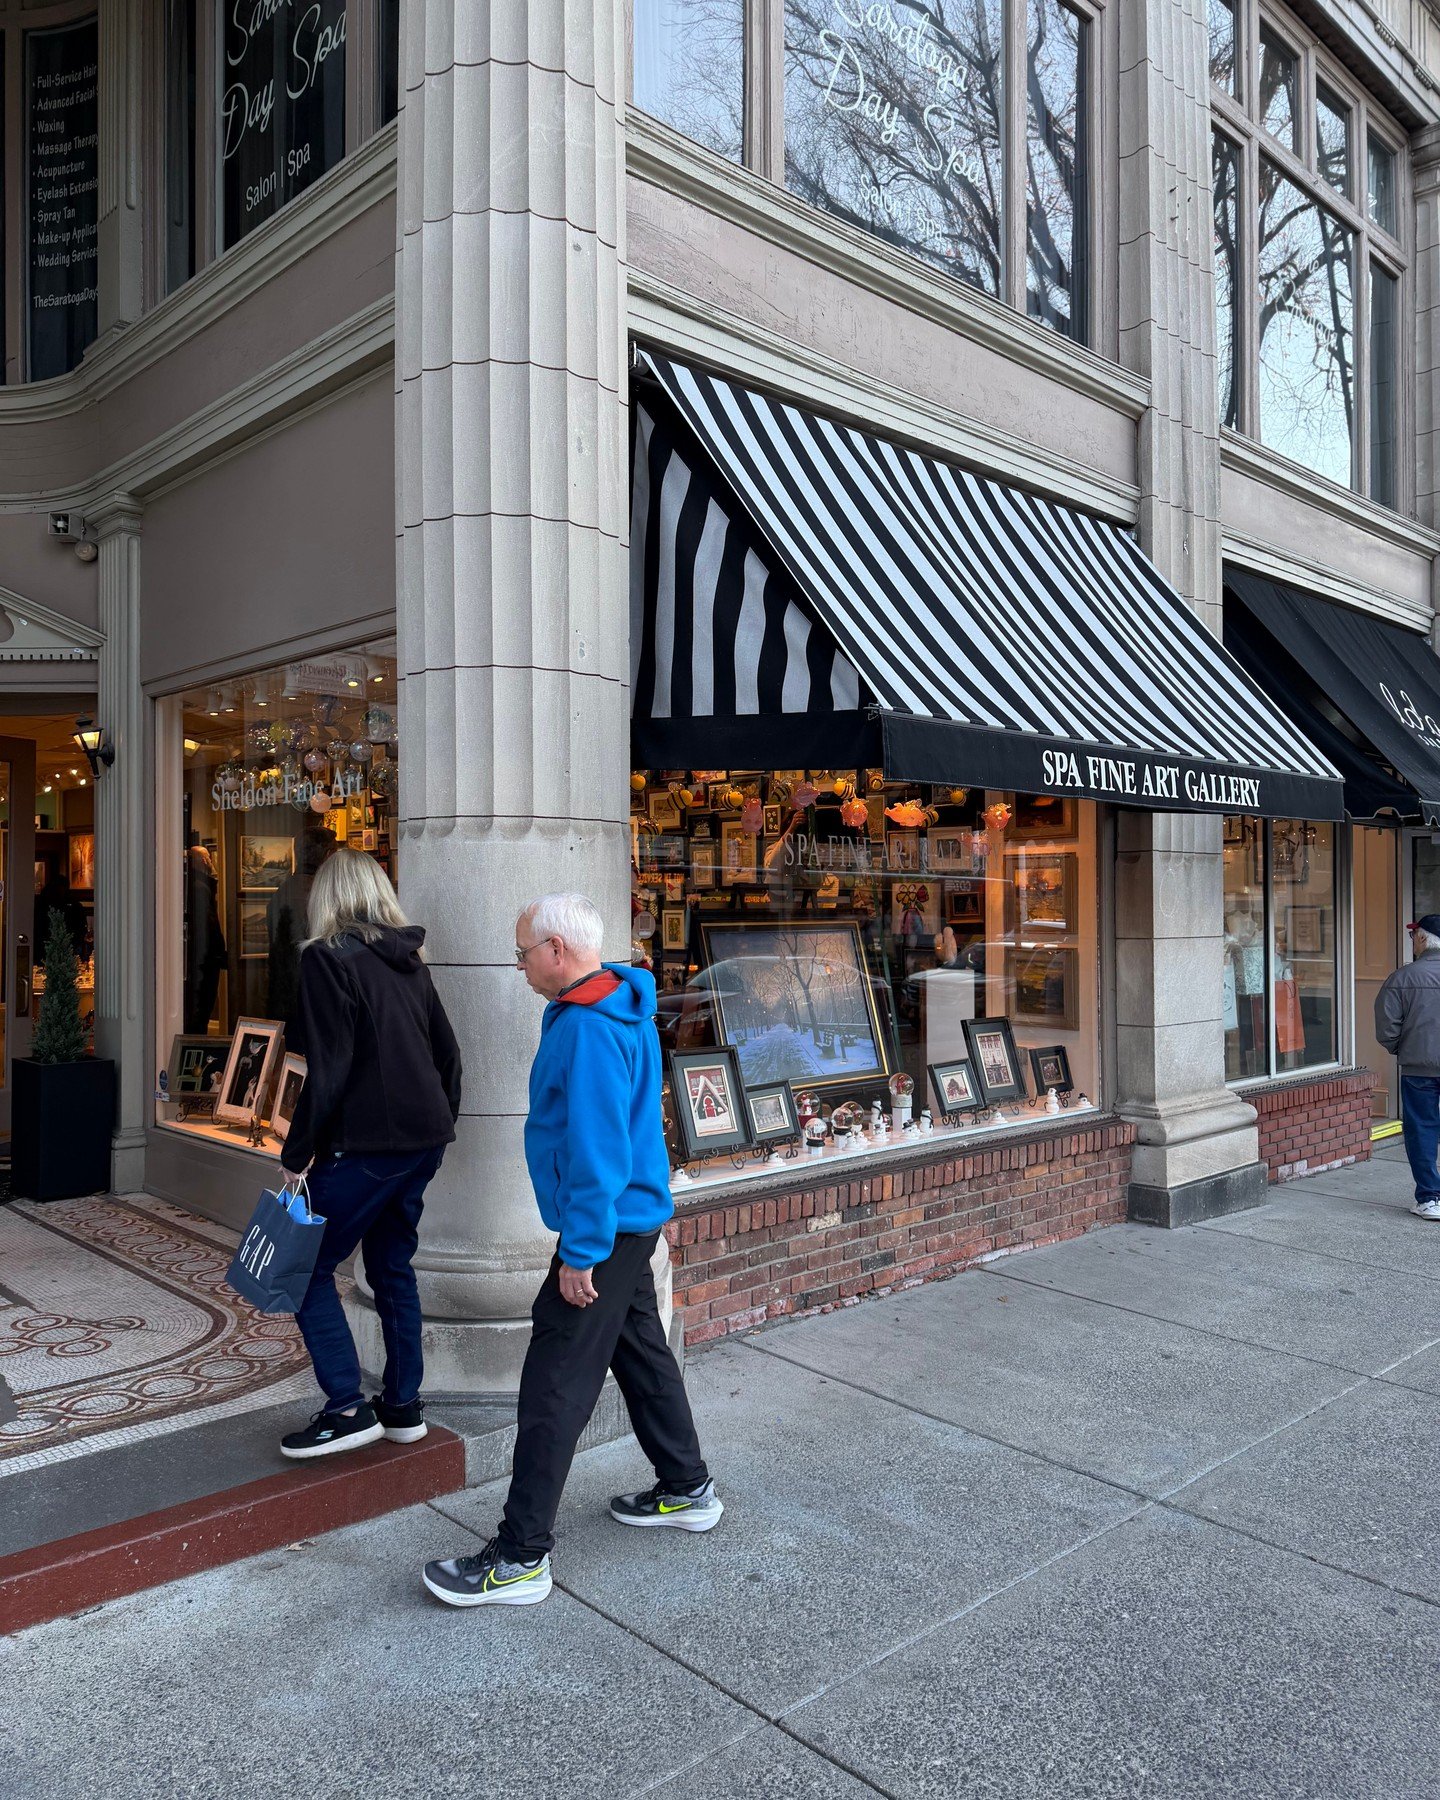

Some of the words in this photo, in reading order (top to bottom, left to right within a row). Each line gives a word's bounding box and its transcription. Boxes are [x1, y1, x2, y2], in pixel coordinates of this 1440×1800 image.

[37, 70, 82, 89] Full-Service
[221, 79, 275, 167] Day
[286, 3, 347, 100] Spa
[37, 92, 75, 111] Advanced
[76, 86, 95, 104] Facial
[819, 29, 900, 144] Day
[916, 103, 982, 188] Spa
[37, 119, 65, 134] Waxing
[37, 141, 72, 155] Massage
[37, 160, 85, 181] Acupuncture
[245, 171, 277, 212] Salon
[288, 142, 311, 177] Spa
[37, 184, 68, 203] Eyelash
[37, 210, 61, 227] Spray
[63, 206, 75, 219] Tan
[37, 230, 71, 246] Make-up
[72, 223, 97, 243] Applica
[37, 253, 70, 267] Wedding
[211, 777, 278, 812] Sheldon
[282, 773, 325, 804] Fine
[330, 766, 364, 799] Art
[1042, 749, 1085, 788] SPA
[1086, 755, 1137, 794] FINE
[1141, 763, 1180, 799] ART
[1184, 769, 1261, 808] GALLERY
[784, 832, 821, 867] SPA
[828, 835, 873, 868] FINE
[881, 838, 920, 870] ART
[239, 1224, 275, 1281] GAP
